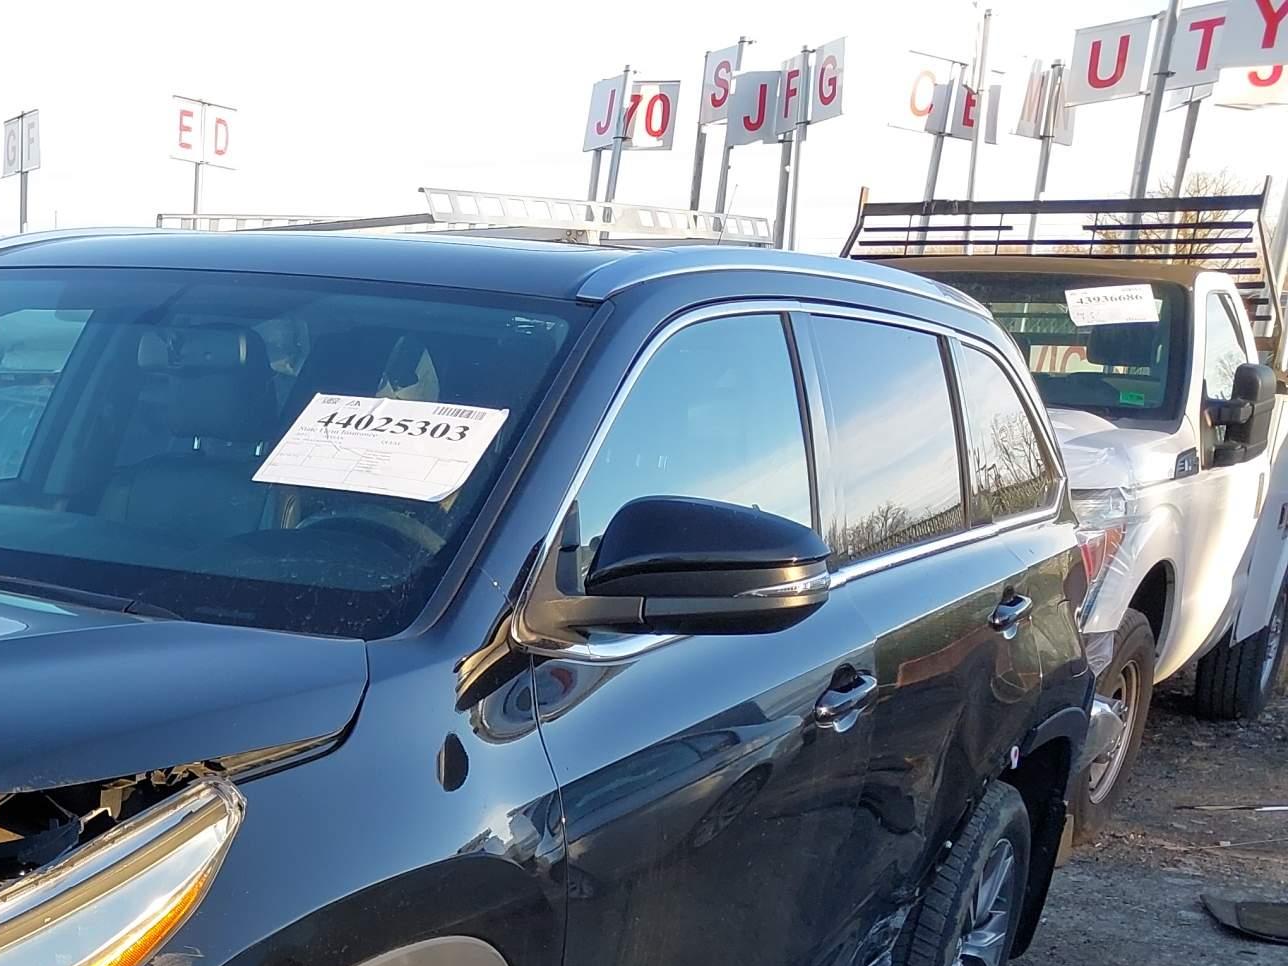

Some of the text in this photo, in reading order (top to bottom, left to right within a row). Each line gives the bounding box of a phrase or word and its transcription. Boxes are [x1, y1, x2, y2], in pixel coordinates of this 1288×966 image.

[1088, 34, 1130, 88] U
[1189, 16, 1226, 72] T
[711, 60, 732, 108] S
[783, 69, 799, 118] F
[819, 55, 837, 106] G
[179, 110, 194, 149] E
[596, 88, 617, 135] J
[743, 83, 768, 132] J
[215, 117, 229, 155] D
[317, 412, 470, 441] 44025303
